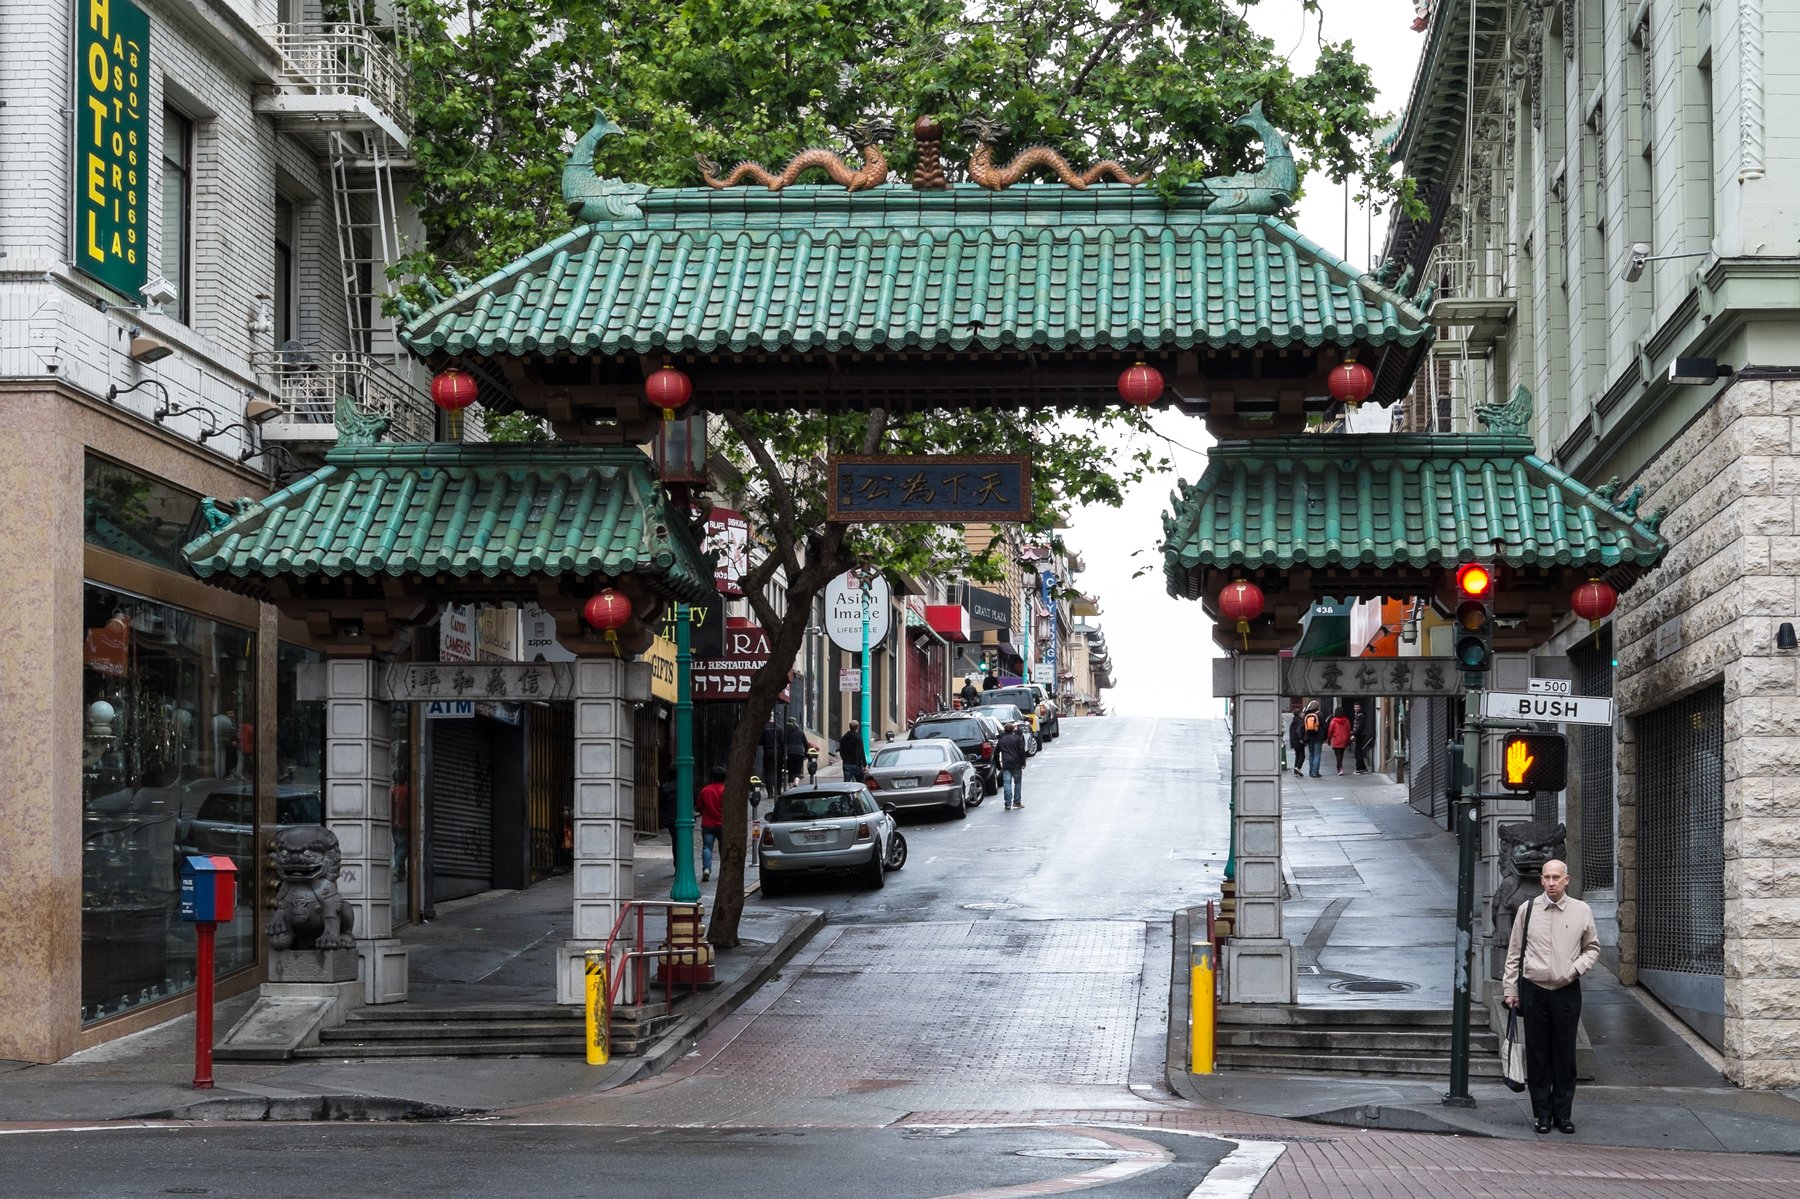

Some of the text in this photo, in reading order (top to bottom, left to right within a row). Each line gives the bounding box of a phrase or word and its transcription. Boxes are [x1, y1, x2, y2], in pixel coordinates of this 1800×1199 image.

[88, 0, 109, 263] HOTEL
[112, 34, 124, 259] ASTORIA
[836, 593, 878, 605] Asin
[834, 608, 880, 619] Imae
[975, 605, 1006, 622] GRANT PLAZA
[1316, 606, 1334, 614] 438
[451, 615, 466, 635] Canon
[661, 625, 677, 642] 41
[445, 635, 471, 656] CAMERAS
[528, 639, 552, 647] zippo
[652, 654, 674, 684] GIFTS
[708, 661, 767, 670] RESTAURAN
[1545, 681, 1567, 692] 500
[430, 701, 471, 713] ATM
[1519, 699, 1578, 717] BUSH
